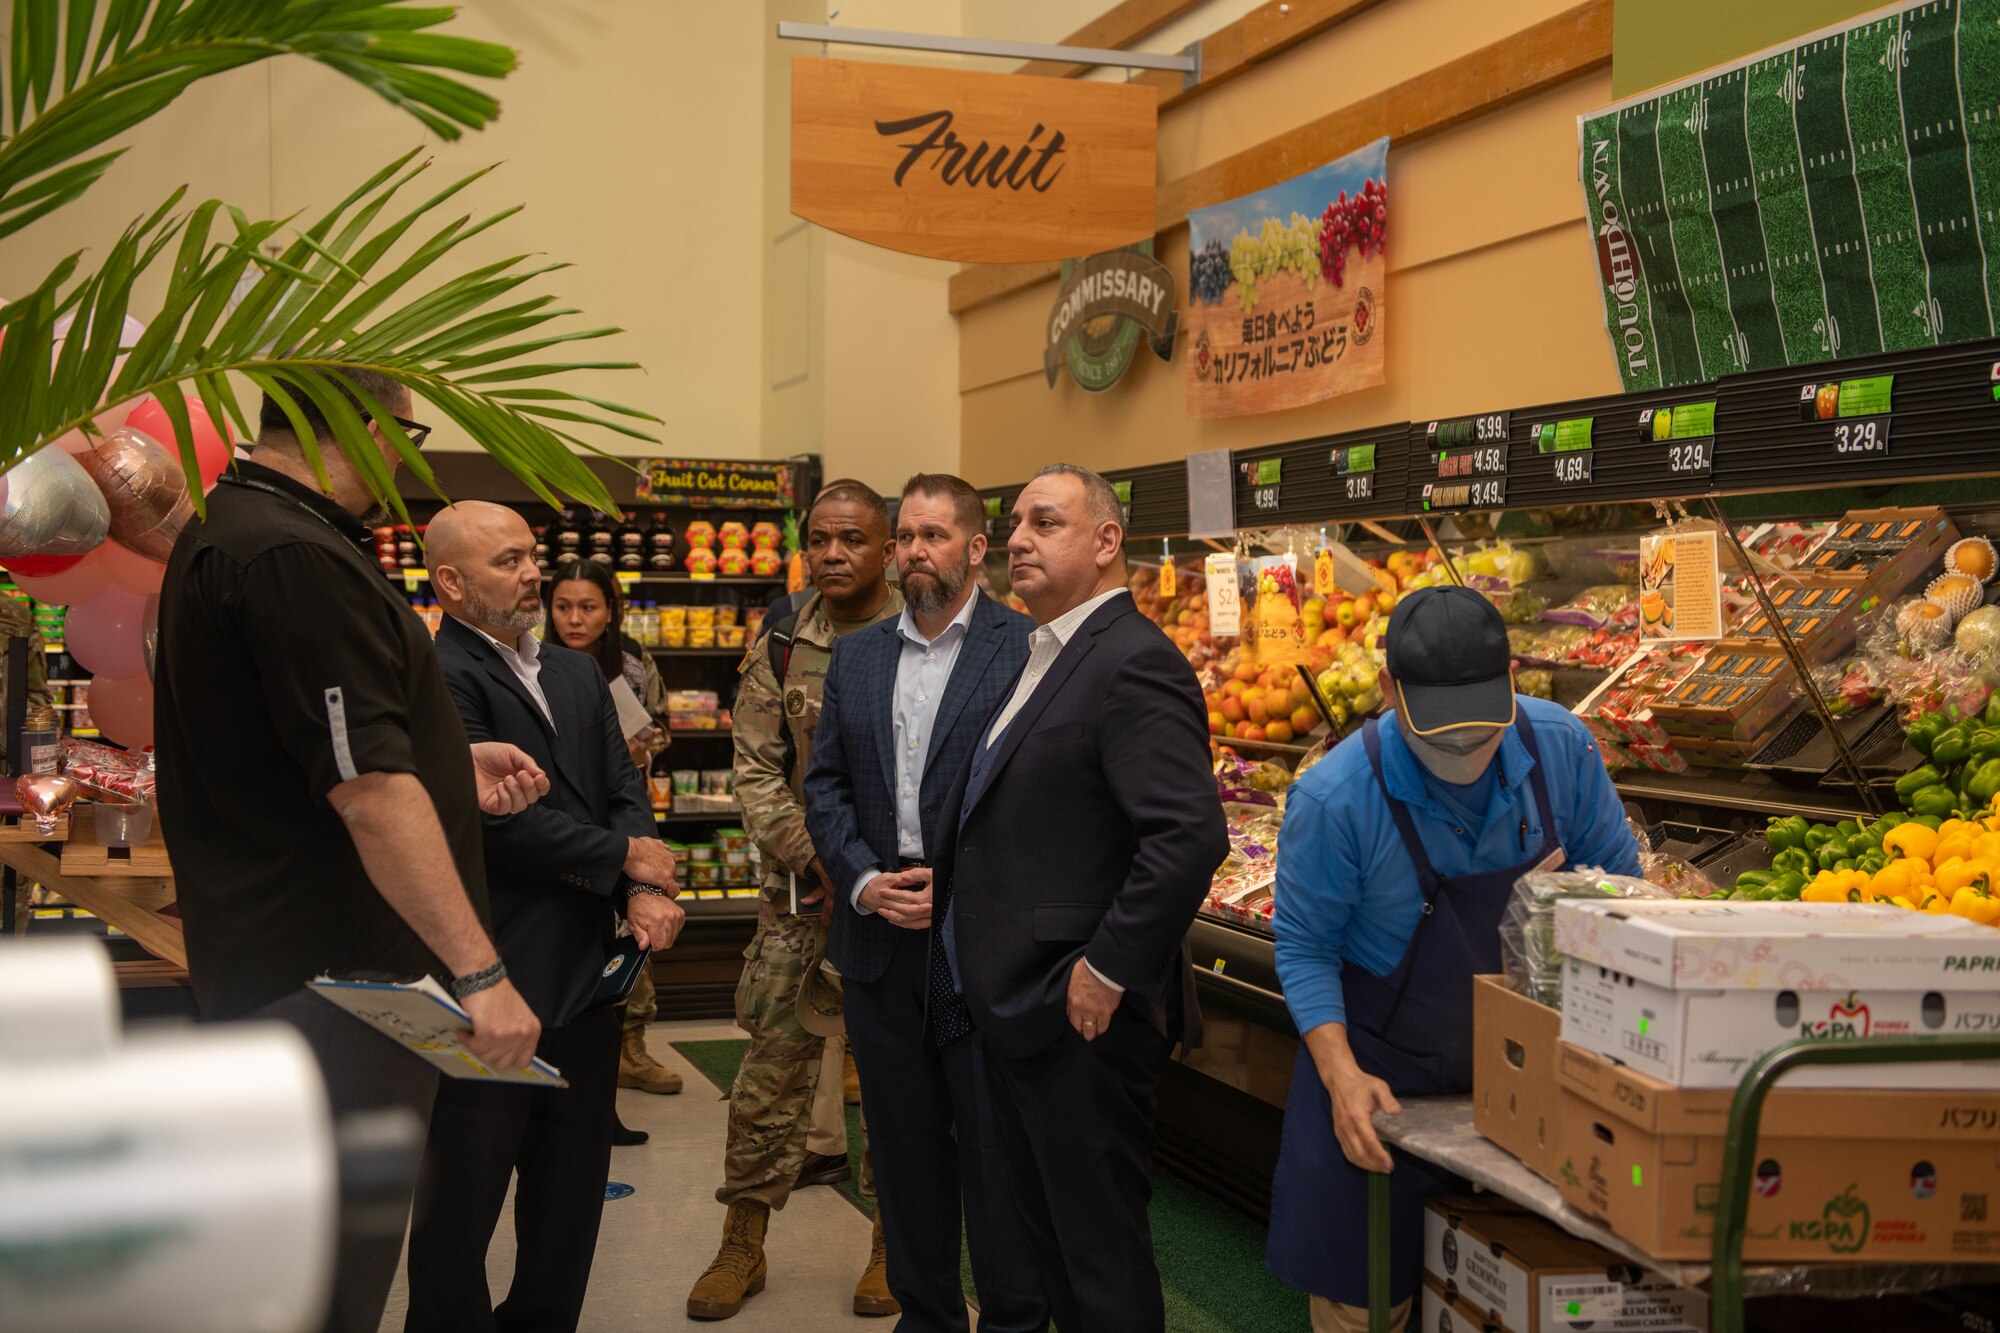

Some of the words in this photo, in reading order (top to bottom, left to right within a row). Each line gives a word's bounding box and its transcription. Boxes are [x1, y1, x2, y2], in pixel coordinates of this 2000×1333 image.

[874, 110, 1066, 192] Fruit
[1591, 138, 1648, 378] TOUCHDOWN
[1051, 268, 1166, 345] COMMISSARY
[1242, 301, 1315, 345] 毎日食べよう
[1213, 326, 1347, 384] カリフォルニアぶどう
[1476, 416, 1502, 440] $5.99
[1835, 422, 1876, 453] $3.29
[1474, 449, 1499, 471] $4.58
[1555, 457, 1583, 482] $4.69
[1669, 444, 1703, 472] $3.29
[652, 470, 694, 488] Fruit
[697, 472, 725, 490] Cut
[729, 473, 777, 493] Corner
[1347, 477, 1367, 499] $3.19
[1471, 481, 1498, 505] $3.49
[1255, 489, 1274, 508] $4.99
[1615, 1305, 1684, 1316] RIMMWAY
